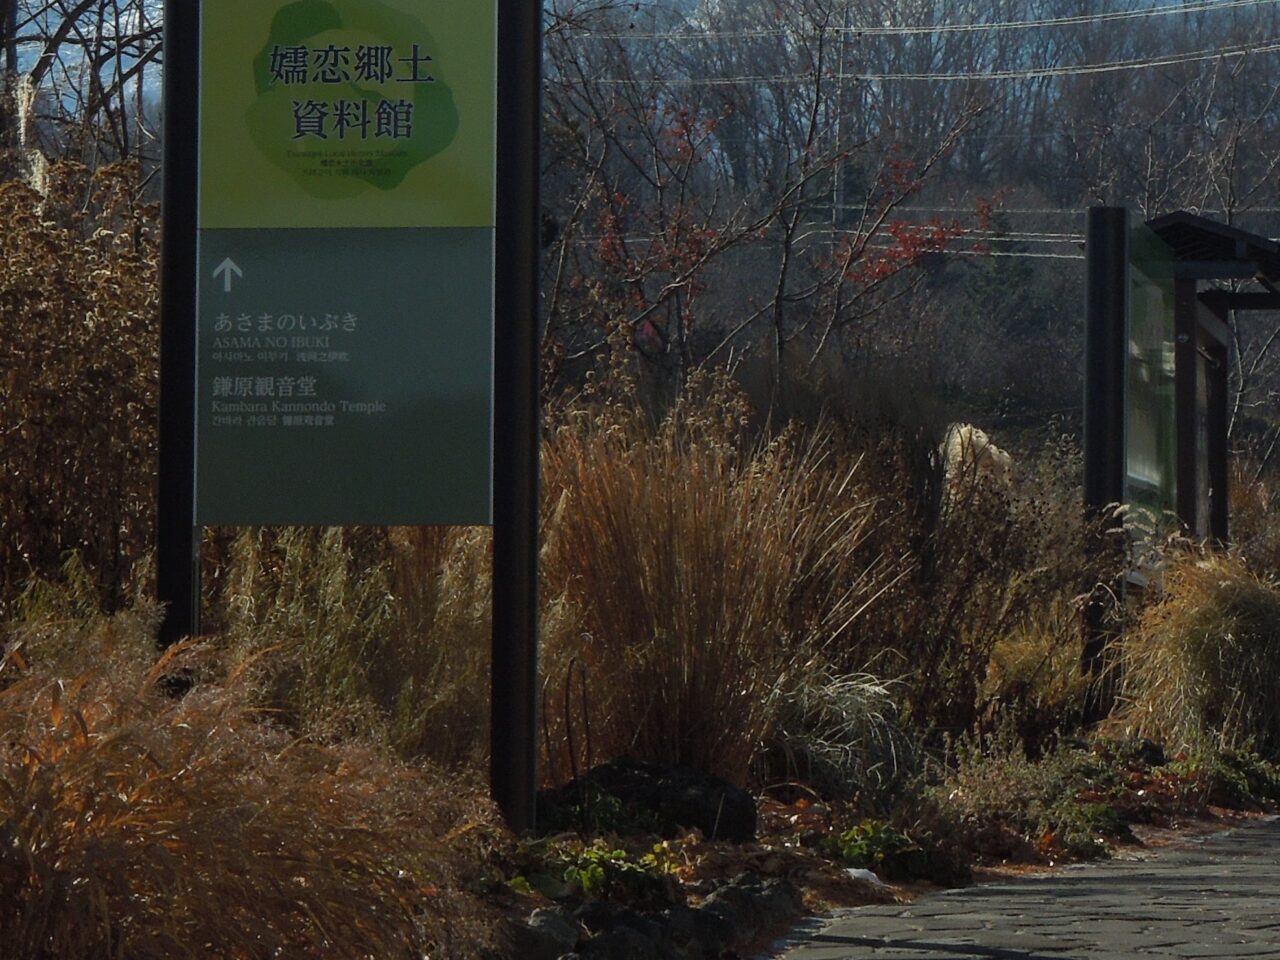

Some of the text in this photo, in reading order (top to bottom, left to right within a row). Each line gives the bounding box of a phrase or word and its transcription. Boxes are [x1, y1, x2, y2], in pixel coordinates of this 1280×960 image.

[269, 43, 435, 86] 嬬恋郷土
[291, 100, 414, 140] 資料館
[213, 312, 359, 332] あさまのいぶき
[212, 336, 330, 348] ASAMA NO IBUKI
[212, 376, 317, 397] 鎌原観音堂
[212, 400, 387, 415] Kambara Kannondo Temple
